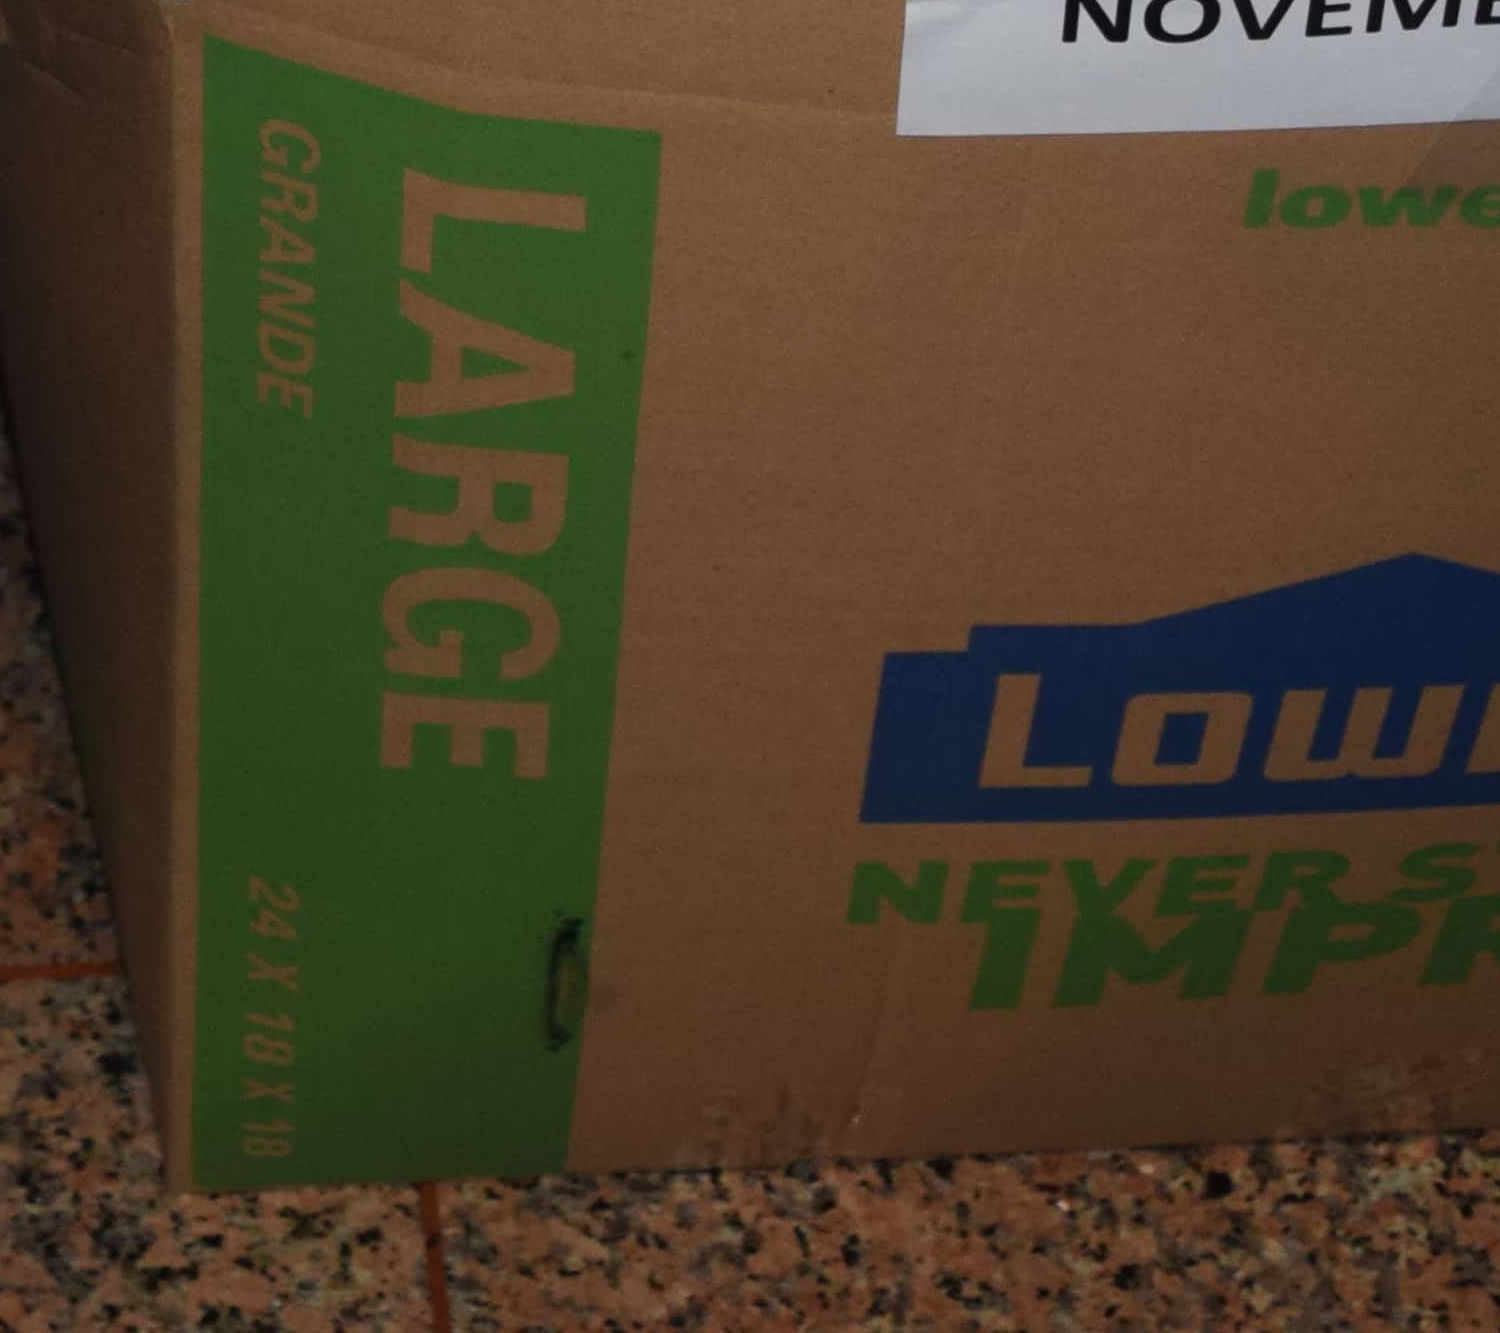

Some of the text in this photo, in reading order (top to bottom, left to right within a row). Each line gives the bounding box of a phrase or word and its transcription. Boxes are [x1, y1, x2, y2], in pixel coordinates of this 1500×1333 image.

[255, 118, 323, 421] GRANDE
[379, 166, 590, 783] LARGE
[240, 874, 302, 1161] 24 X 18 X 18
[844, 846, 1362, 931] NEVER
